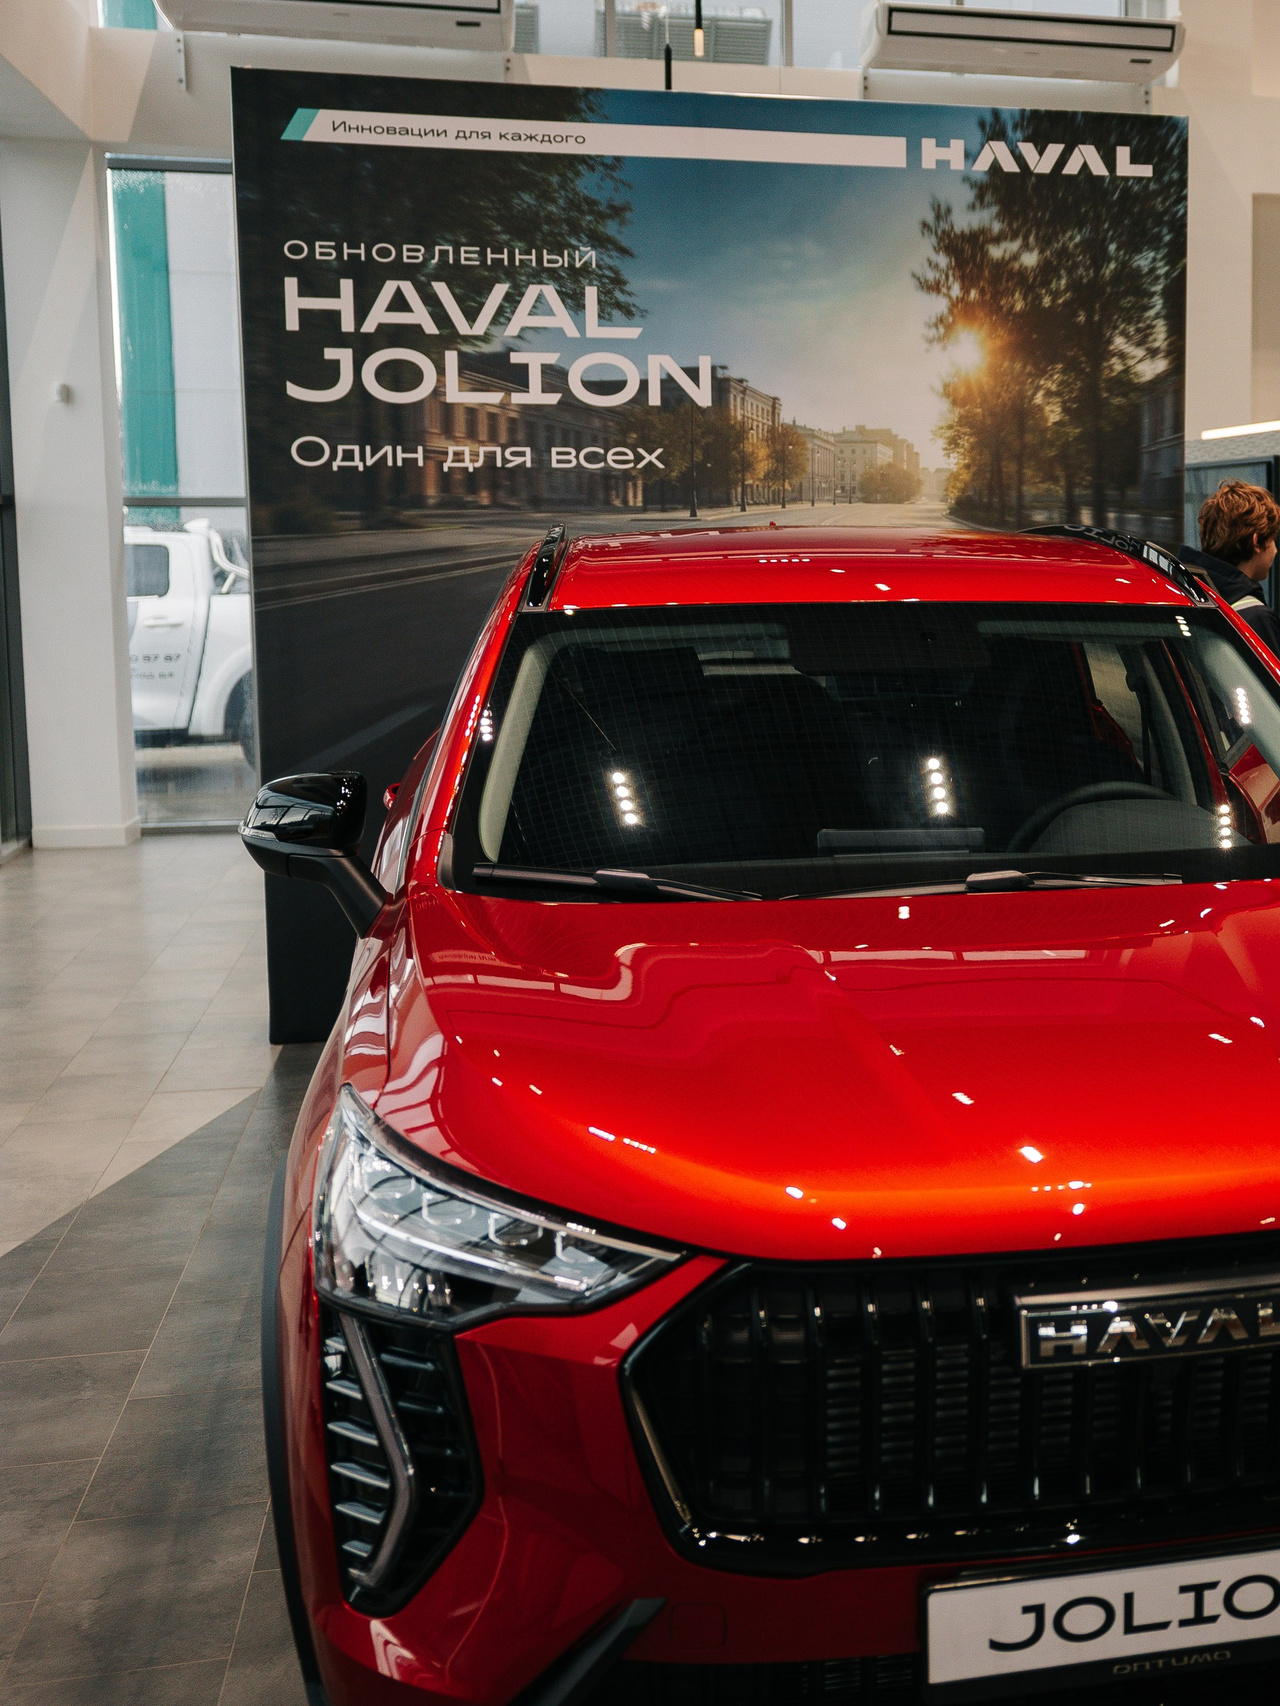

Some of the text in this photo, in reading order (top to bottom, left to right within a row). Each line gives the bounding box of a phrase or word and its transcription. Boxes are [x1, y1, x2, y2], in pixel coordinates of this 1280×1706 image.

[331, 119, 586, 146] Инновации для каждого
[921, 138, 1153, 177] HAVAL
[283, 239, 597, 269] ОБНОВЛЕННЫЙ
[283, 276, 643, 339] HAVAL
[286, 346, 712, 408] JOLION
[290, 435, 665, 473] Один для всех
